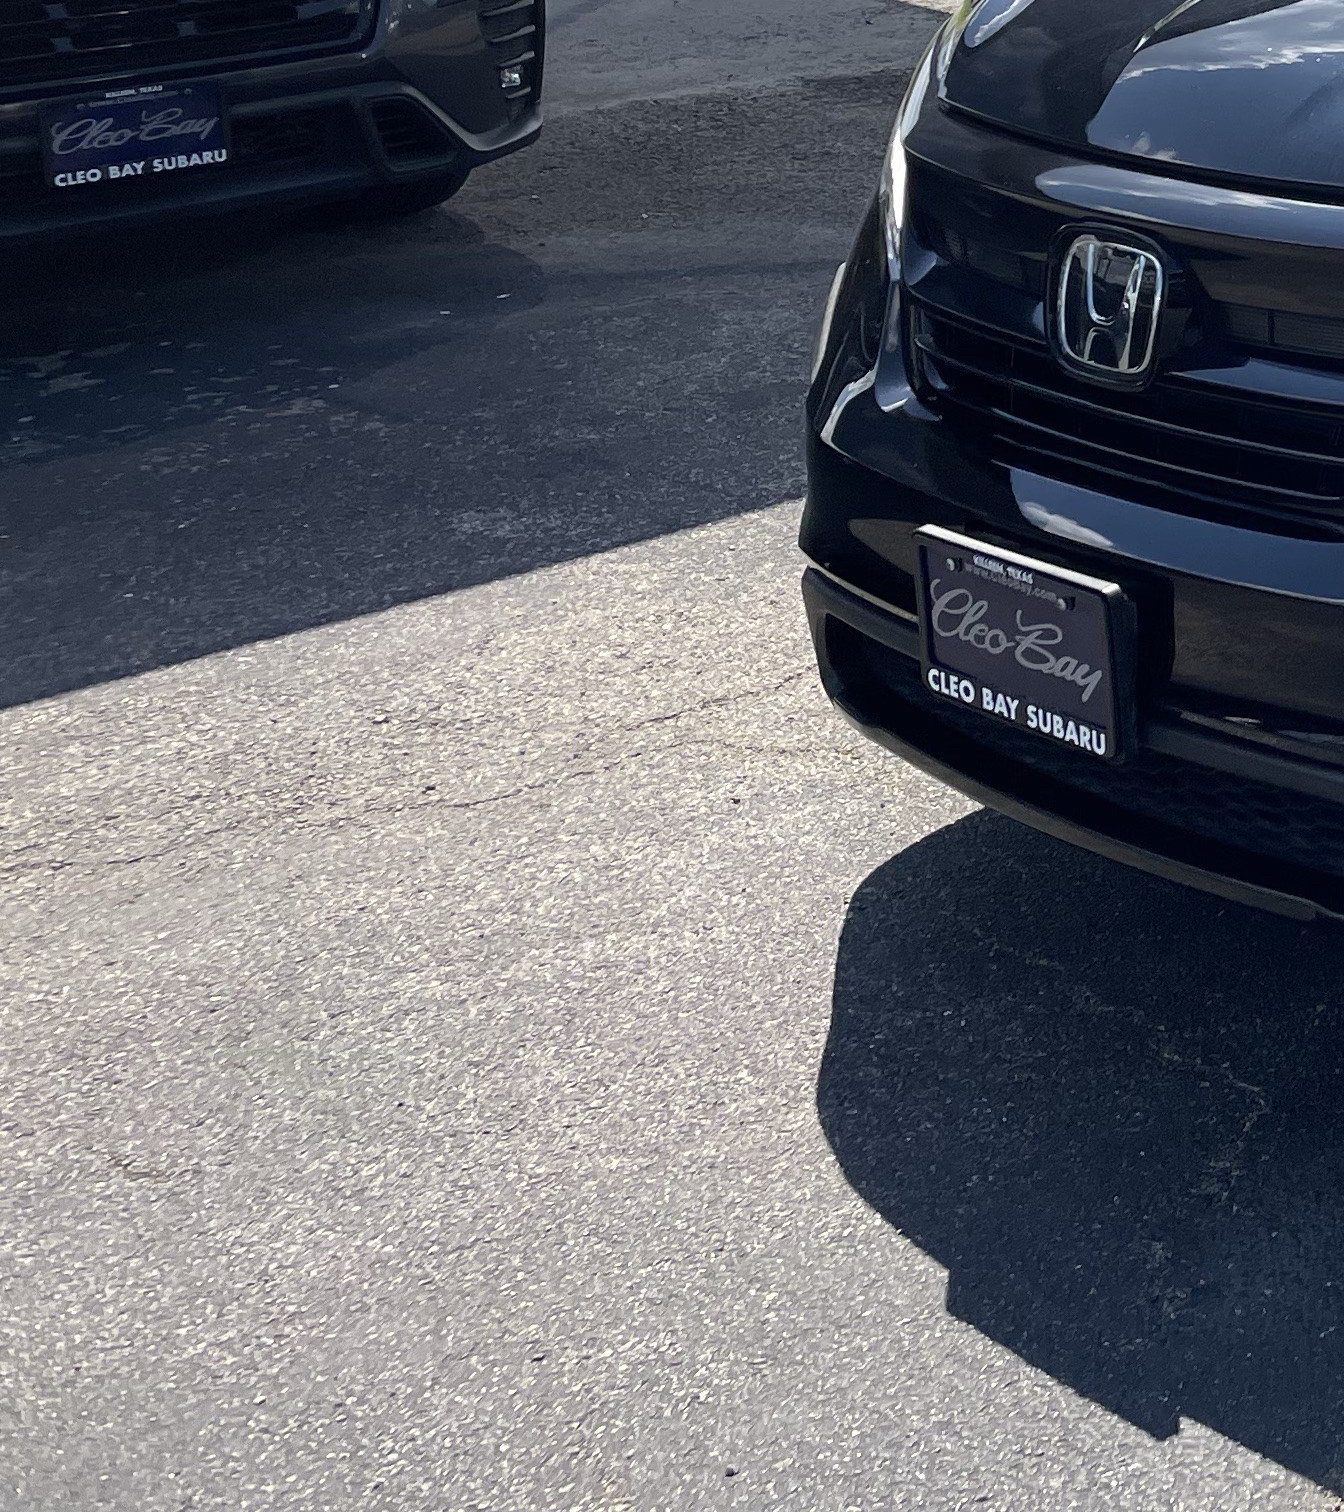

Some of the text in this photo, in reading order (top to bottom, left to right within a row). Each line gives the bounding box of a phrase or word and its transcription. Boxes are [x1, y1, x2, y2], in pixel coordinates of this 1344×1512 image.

[51, 107, 220, 155] Cleo Bay
[54, 148, 228, 187] CLEO BAY SUBARU
[929, 578, 1015, 655] Cleo
[1013, 608, 1102, 703] Bay
[927, 668, 1107, 756] CLEO BAY SUBARU
